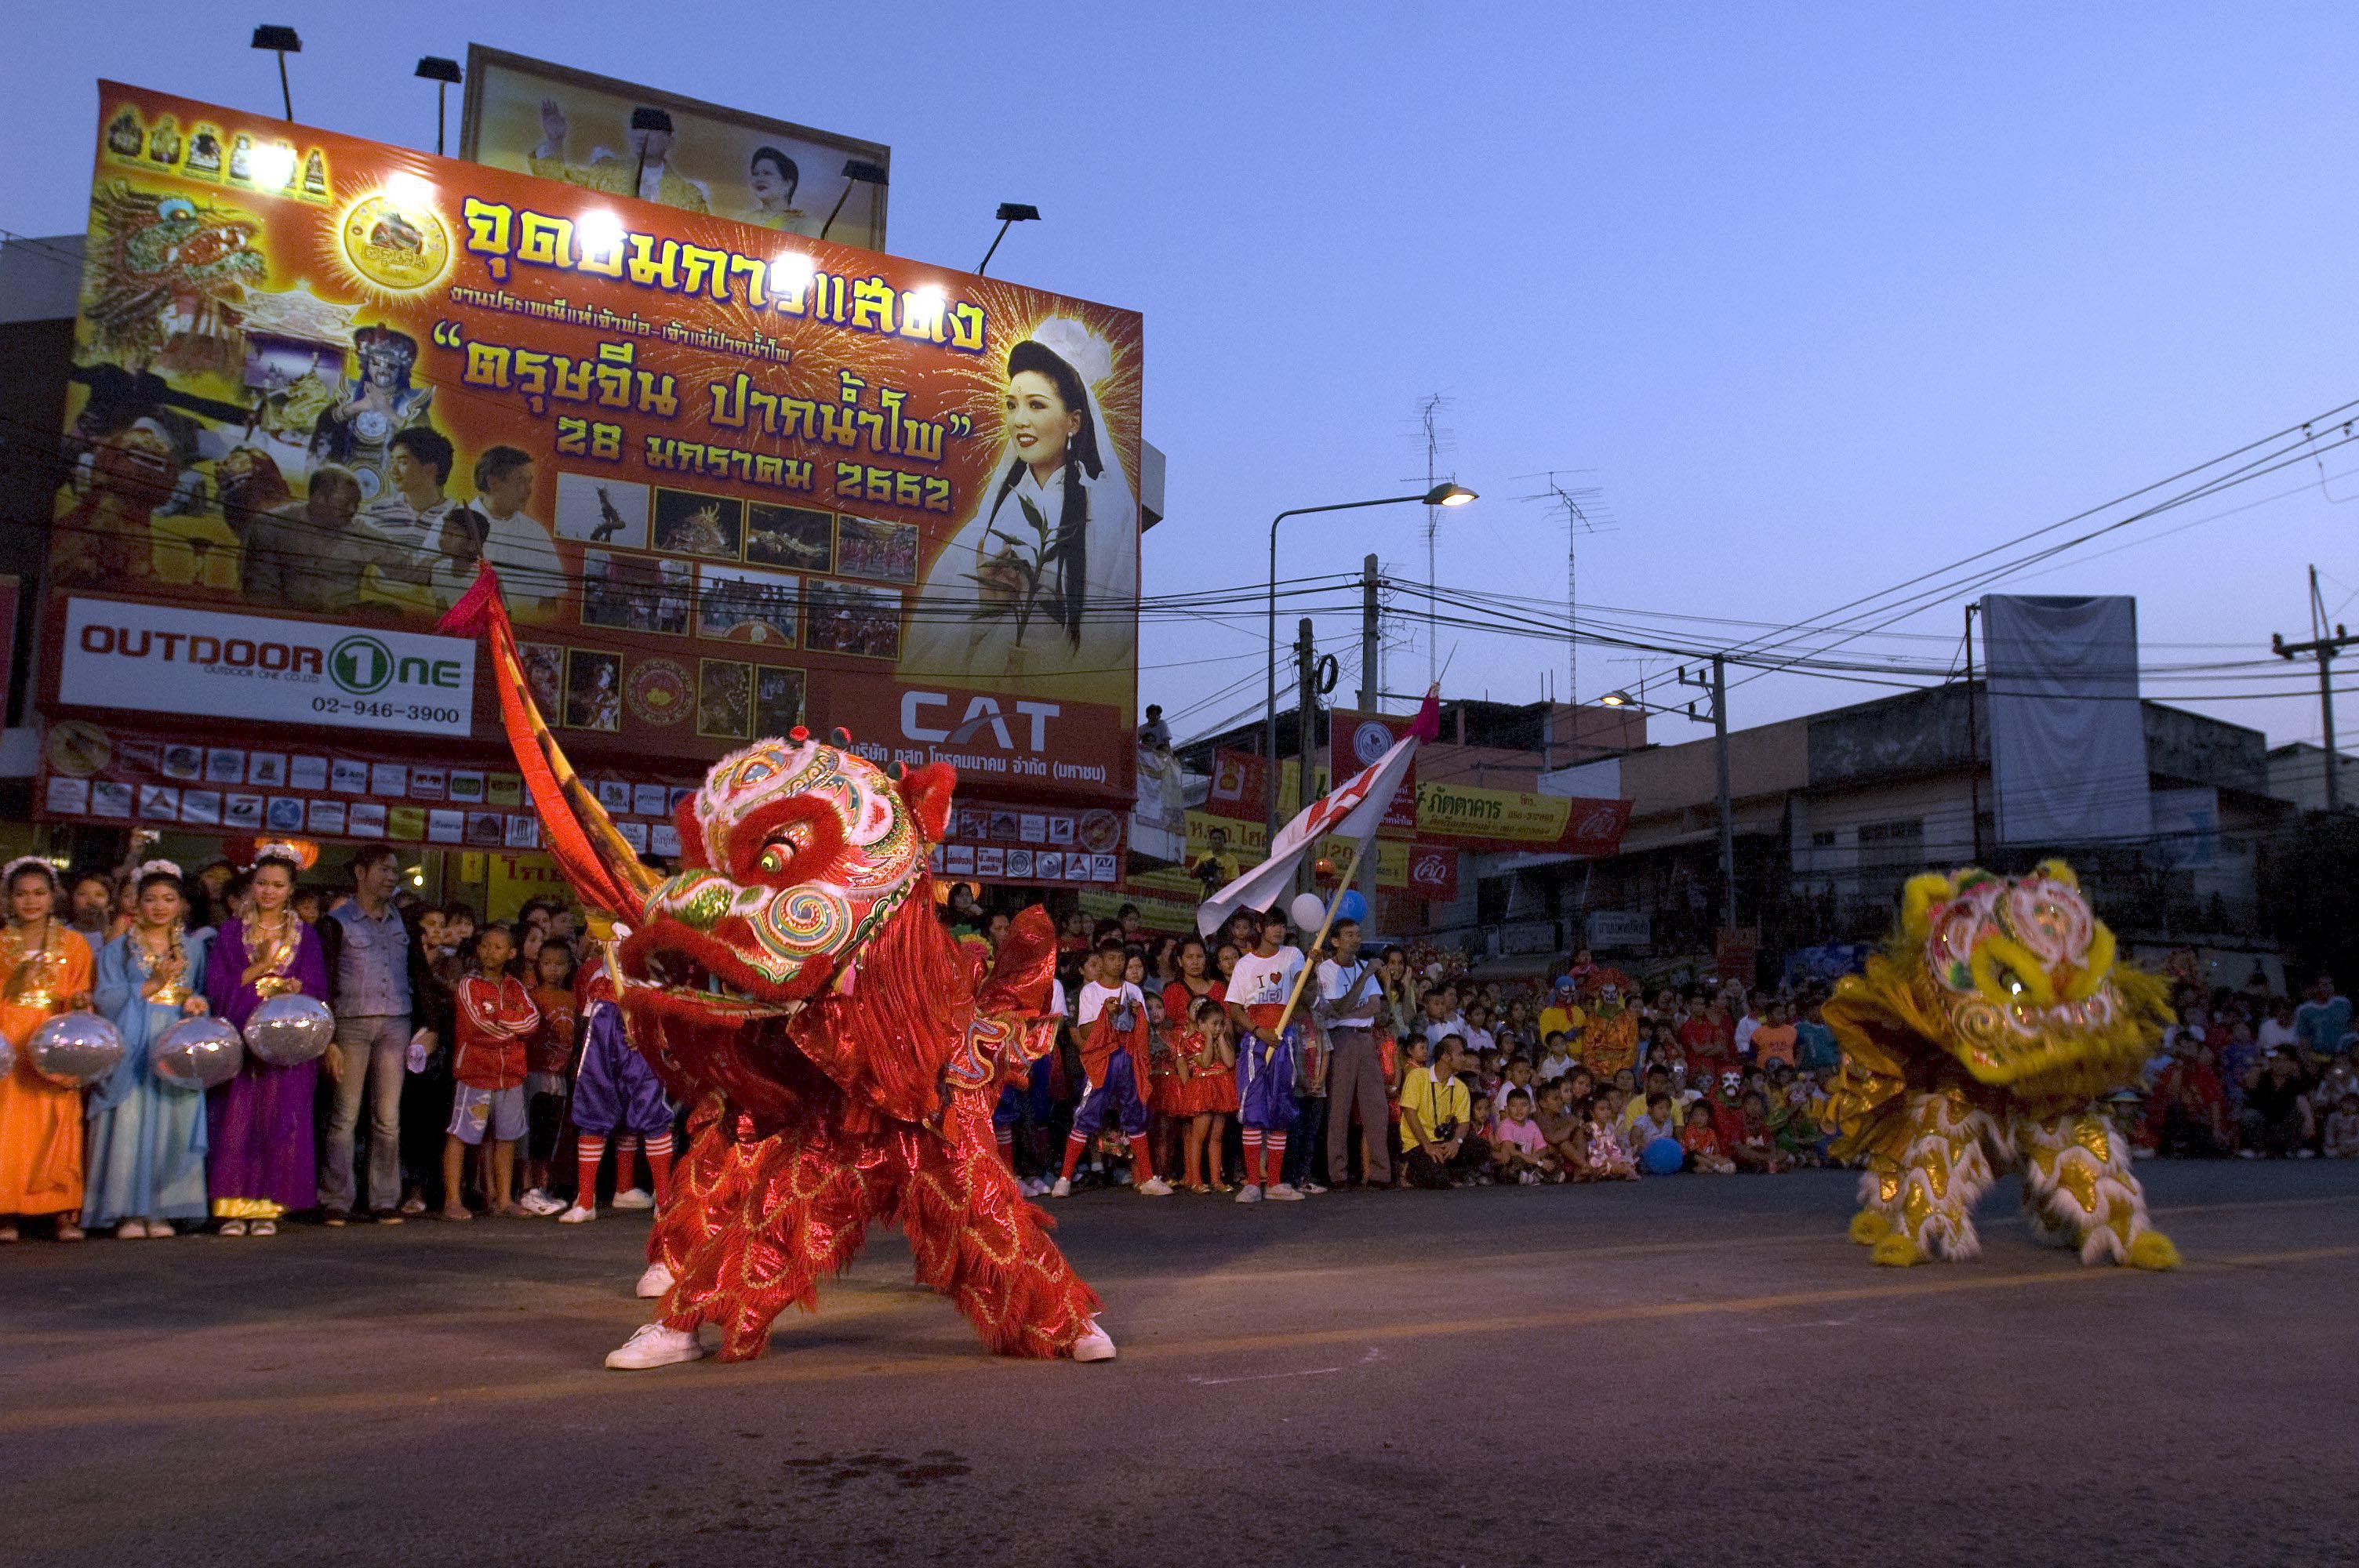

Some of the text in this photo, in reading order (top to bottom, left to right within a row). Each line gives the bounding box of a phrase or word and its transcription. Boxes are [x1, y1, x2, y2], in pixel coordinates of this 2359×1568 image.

[556, 416, 950, 511] 28 มกราคม 2552
[80, 625, 323, 675] OUTDOOR
[204, 665, 254, 679] OUTDOOR
[258, 669, 280, 681] ONE
[312, 696, 460, 724] 02-946-3900
[901, 691, 1060, 752] CAT
[850, 742, 889, 762] บริษัท
[1012, 756, 1047, 775] จำกัด
[1053, 764, 1107, 783] (มหาชน)
[1427, 786, 1503, 819] ภัตตาคาร
[1256, 975, 1265, 989] I
